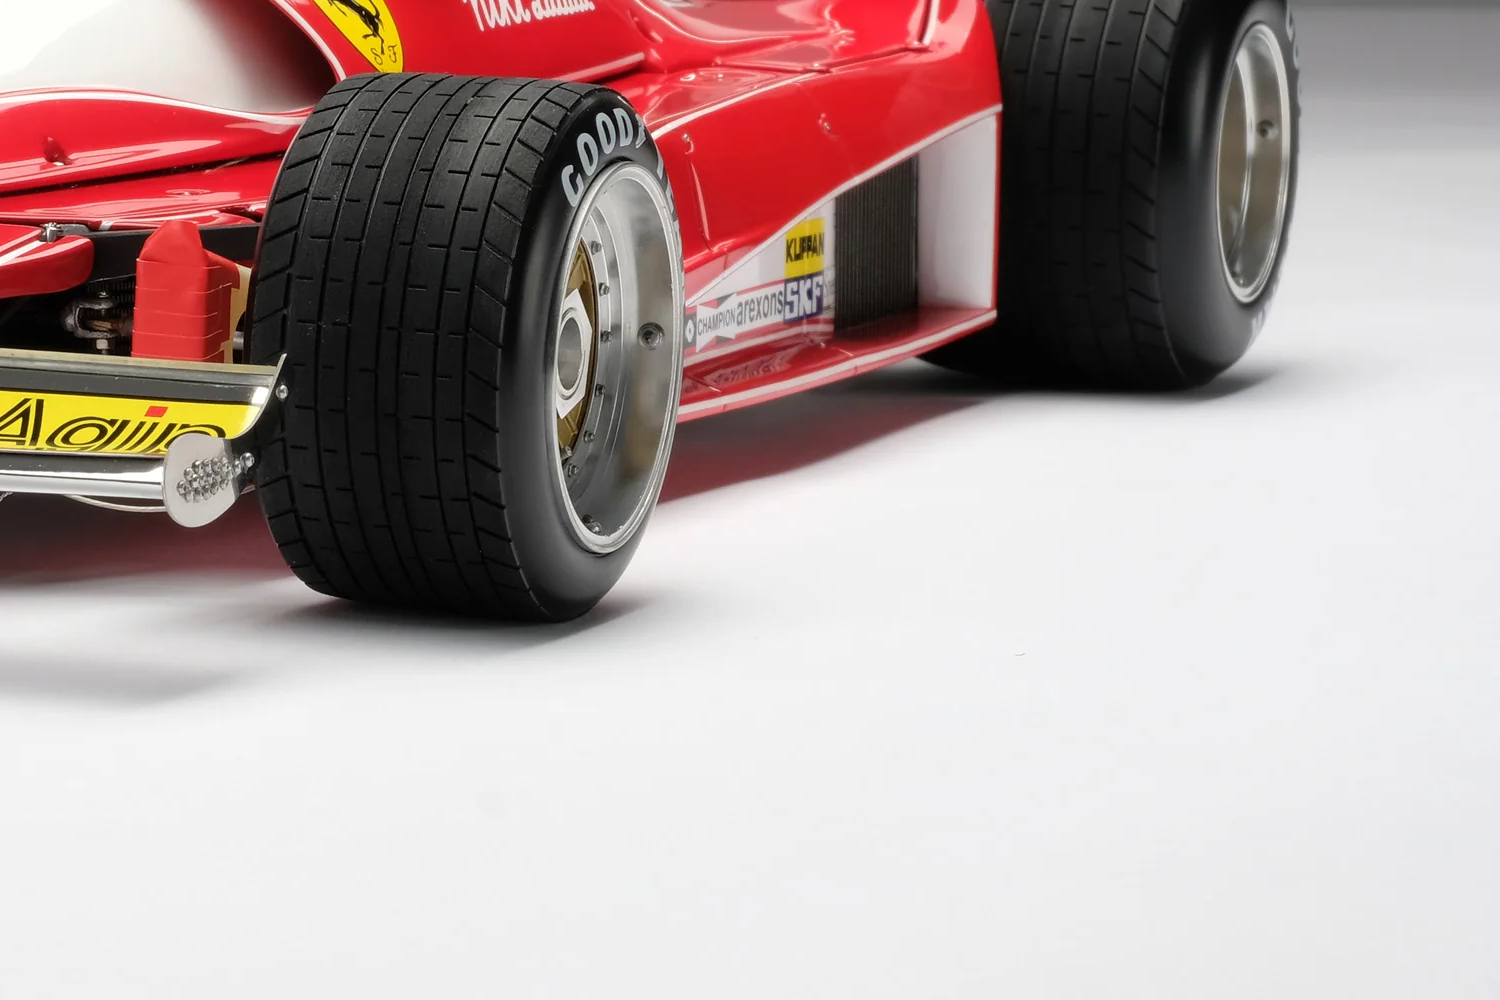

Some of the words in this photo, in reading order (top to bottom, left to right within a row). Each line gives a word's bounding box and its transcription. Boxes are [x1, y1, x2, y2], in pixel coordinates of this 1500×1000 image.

[370, 47, 384, 66] S
[561, 107, 634, 208] GOOD
[697, 307, 736, 337] CHAMPION
[735, 290, 784, 327] arexons
[784, 275, 824, 320] SKF
